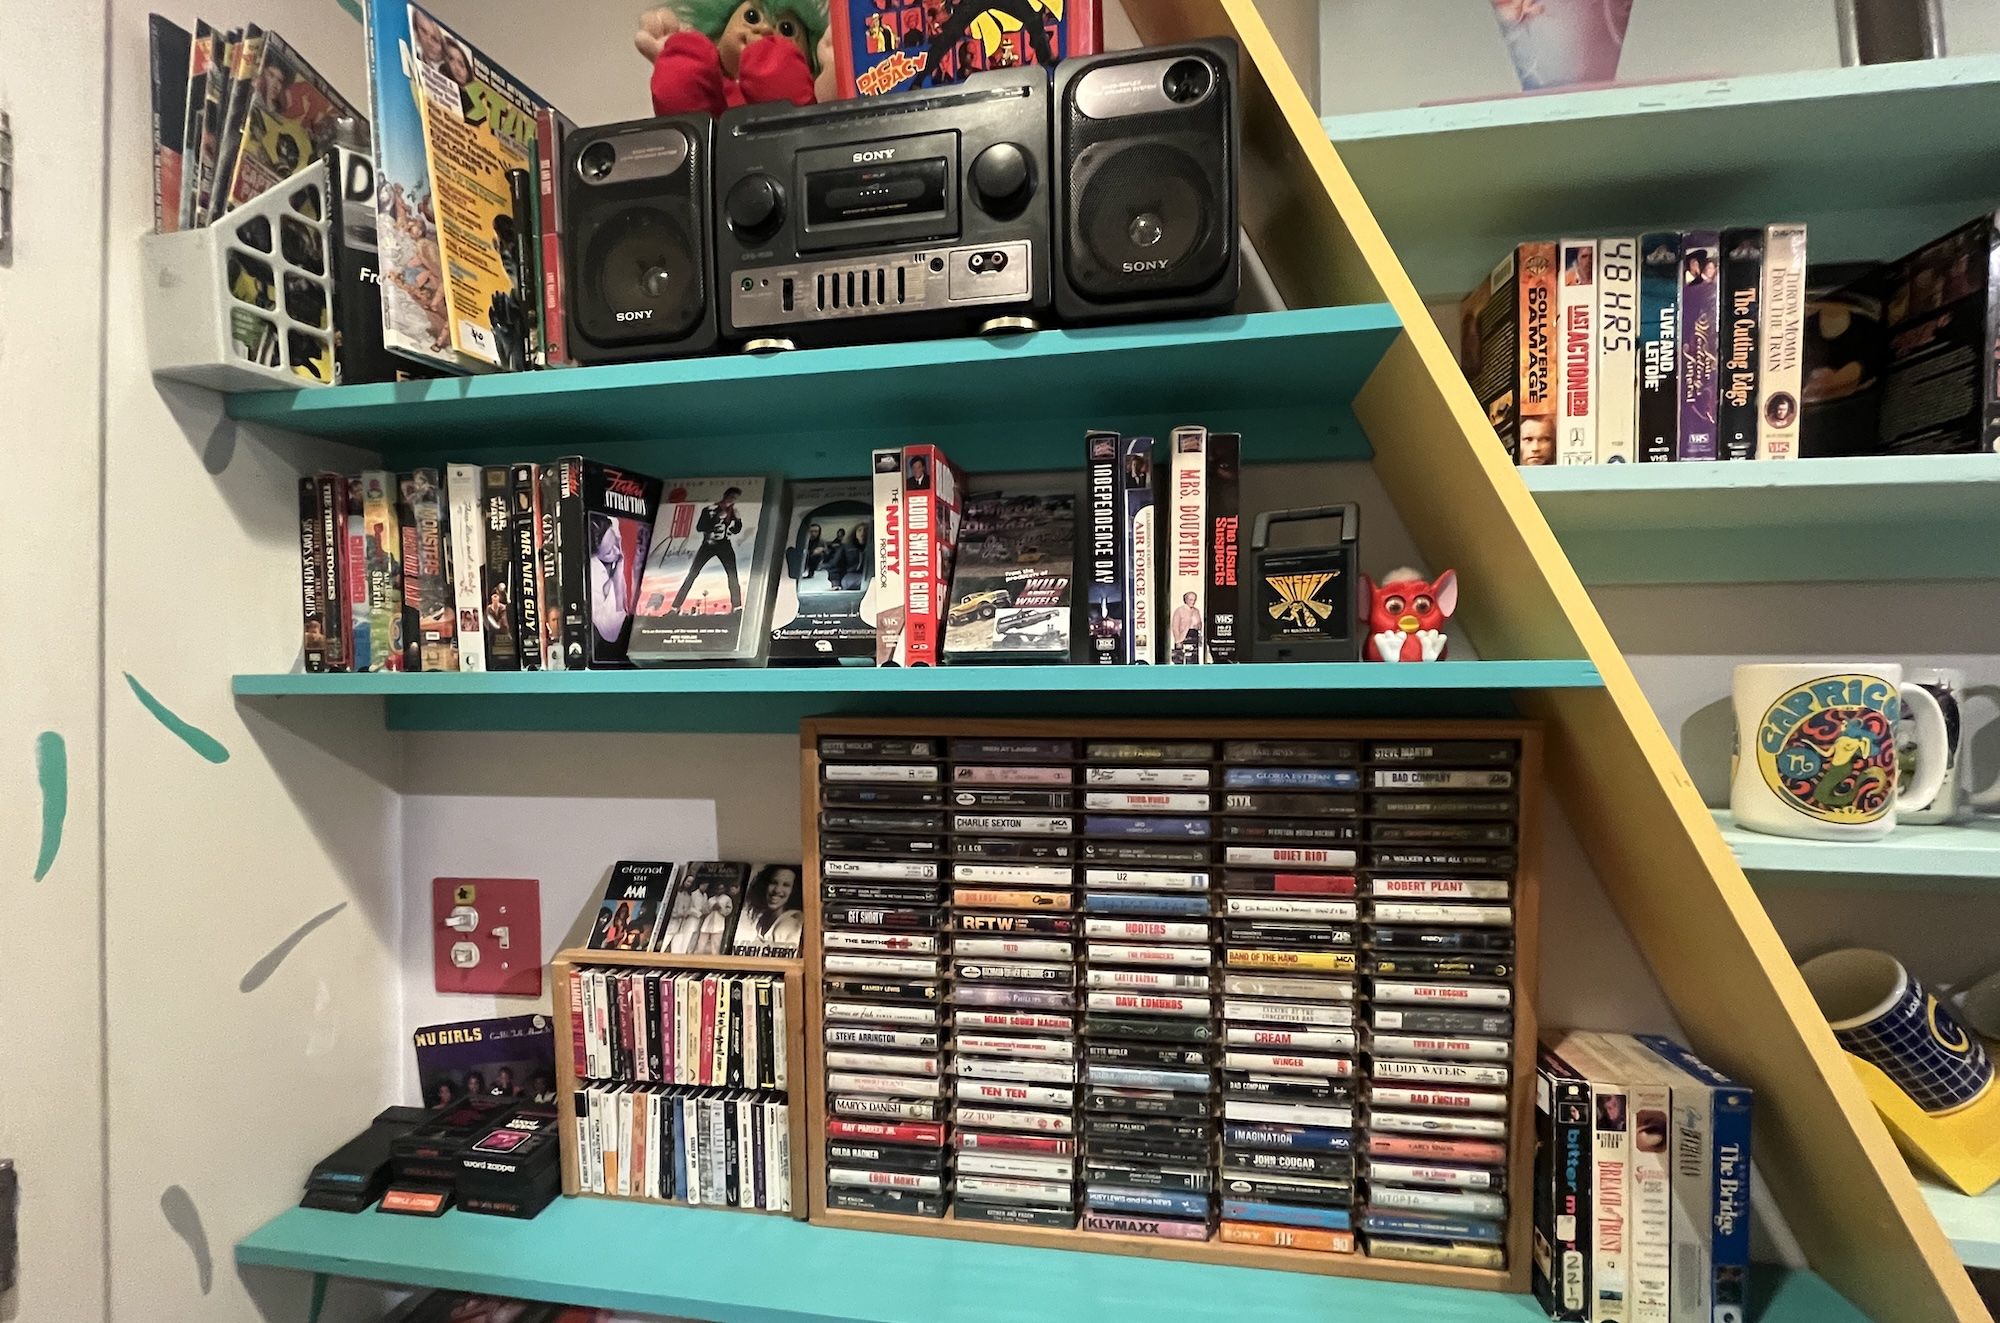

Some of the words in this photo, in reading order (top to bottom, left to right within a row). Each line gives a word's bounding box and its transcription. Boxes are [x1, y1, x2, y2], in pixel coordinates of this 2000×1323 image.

[856, 51, 905, 94] DICK
[864, 52, 928, 96] TRACY
[853, 148, 896, 162] SONY
[1122, 259, 1168, 272] SONY
[1604, 244, 1632, 282] 48
[1772, 268, 1786, 305] FROM
[1734, 288, 1756, 316] The
[616, 310, 653, 322] SONY
[1574, 305, 1589, 329] LAST
[1604, 292, 1632, 354] HRS.
[1770, 308, 1783, 328] THE
[1528, 288, 1539, 404] DAMAGE
[1538, 287, 1548, 402] COLLATERAL
[1726, 320, 1754, 370] Cutting
[1769, 334, 1783, 372] TRAIN
[1784, 320, 1799, 370] MOMMA
[1567, 332, 1589, 390] ACTION
[1726, 372, 1754, 408] Edge
[1690, 434, 1708, 444] VHS
[323, 486, 332, 506] THE
[603, 469, 646, 498] Fatal
[1180, 469, 1201, 500] MRS.
[490, 496, 499, 531] WARS
[498, 496, 507, 531] STAR
[604, 491, 647, 516] ATTRACTION
[909, 496, 928, 529] BLOOD
[1094, 464, 1114, 556] INDEPENDENCE
[303, 519, 313, 532] SIX
[324, 508, 334, 546] THREE
[542, 513, 554, 542] CON
[1136, 522, 1145, 548] AIR
[1226, 514, 1239, 544] The
[303, 534, 314, 556] DAYS
[521, 530, 534, 562] MR.
[886, 506, 901, 576] NUTTY
[909, 534, 929, 568] SWEAT
[1178, 504, 1200, 576] DOUBTFIRE
[1215, 516, 1227, 586] Suspects
[304, 556, 315, 583] SEVEN
[325, 547, 336, 600] STOOGES
[544, 550, 554, 578] AIR
[880, 538, 888, 589] PROFESSOR
[1095, 560, 1114, 584] DAY
[1136, 550, 1146, 596] FORCE
[1226, 545, 1238, 586] Usual
[522, 564, 534, 598] NICE
[1024, 579, 1069, 590] WILD
[305, 586, 316, 617] NIGHTS
[910, 582, 929, 615] GLORY
[1014, 597, 1060, 606] WHEELS
[524, 600, 536, 632] GUY
[1136, 600, 1146, 630] ONE
[1215, 614, 1234, 624] VHS
[773, 630, 780, 640] 3
[1392, 774, 1408, 782] BAD
[1412, 774, 1450, 782] COMPANY
[1227, 795, 1251, 807] STYX
[957, 818, 989, 827] CHARLIE
[992, 819, 1021, 827] SEXTON
[1274, 850, 1302, 860] QUIET
[1305, 851, 1328, 862] RIOT
[622, 866, 663, 874] eternal
[1387, 882, 1426, 890] ROBERT
[1431, 882, 1463, 891] PLANT
[848, 910, 859, 923] GET
[860, 911, 884, 924] SHORTY
[1126, 923, 1166, 934] HOOTERS
[1229, 952, 1248, 960] BAND
[1262, 953, 1276, 961] THE
[1278, 954, 1298, 963] HAND
[1116, 996, 1138, 1008] DAVE
[1141, 998, 1183, 1010] EDMUNDS
[1414, 988, 1436, 996] KENNY
[1439, 989, 1468, 998] LOGGINS
[984, 1016, 1007, 1024] MIAMI
[1010, 1017, 1035, 1026] SOUND
[1038, 1018, 1069, 1028] MACHINE
[414, 1032, 436, 1048] NU
[438, 1027, 482, 1046] GIRLS
[835, 1032, 855, 1040] STEVE
[858, 1032, 896, 1043] ARRINGTON
[1254, 1032, 1291, 1044] CREAM
[1272, 1058, 1304, 1067] WINGER
[1379, 1064, 1418, 1072] MUDDY
[1422, 1066, 1466, 1075] WATERS
[981, 1086, 1001, 1097] TEN
[1006, 1088, 1027, 1098] TEN
[1243, 1082, 1270, 1091] COMPANY
[836, 1100, 867, 1110] MARY'S
[870, 1102, 901, 1113] DANISH
[1410, 1094, 1429, 1104] BAD
[1432, 1095, 1470, 1107] ENGLISH
[842, 1123, 855, 1132] RAY
[858, 1125, 884, 1134] PARKER
[886, 1126, 896, 1135] JR.
[962, 1111, 975, 1119] ZZ
[978, 1112, 995, 1121] TOP
[1235, 1130, 1292, 1144] IMAGINATION
[1331, 1138, 1349, 1146] MCA
[831, 1147, 851, 1156] GILDA
[852, 1148, 879, 1159] RADNER
[1254, 1155, 1276, 1165] JOHN
[1279, 1156, 1315, 1168] COUGAR
[1566, 1129, 1580, 1192] bitter
[1720, 1143, 1739, 1174] The
[464, 1160, 486, 1170] word
[486, 1162, 516, 1173] zapper
[869, 1173, 891, 1183] EDDIE
[894, 1175, 920, 1186] MONEY
[1598, 1161, 1623, 1206] BREACH
[1714, 1178, 1738, 1236] Bridge
[1088, 1217, 1160, 1233] KLYMAXX
[1566, 1195, 1577, 1252] mn
[1598, 1216, 1624, 1254] TRUST
